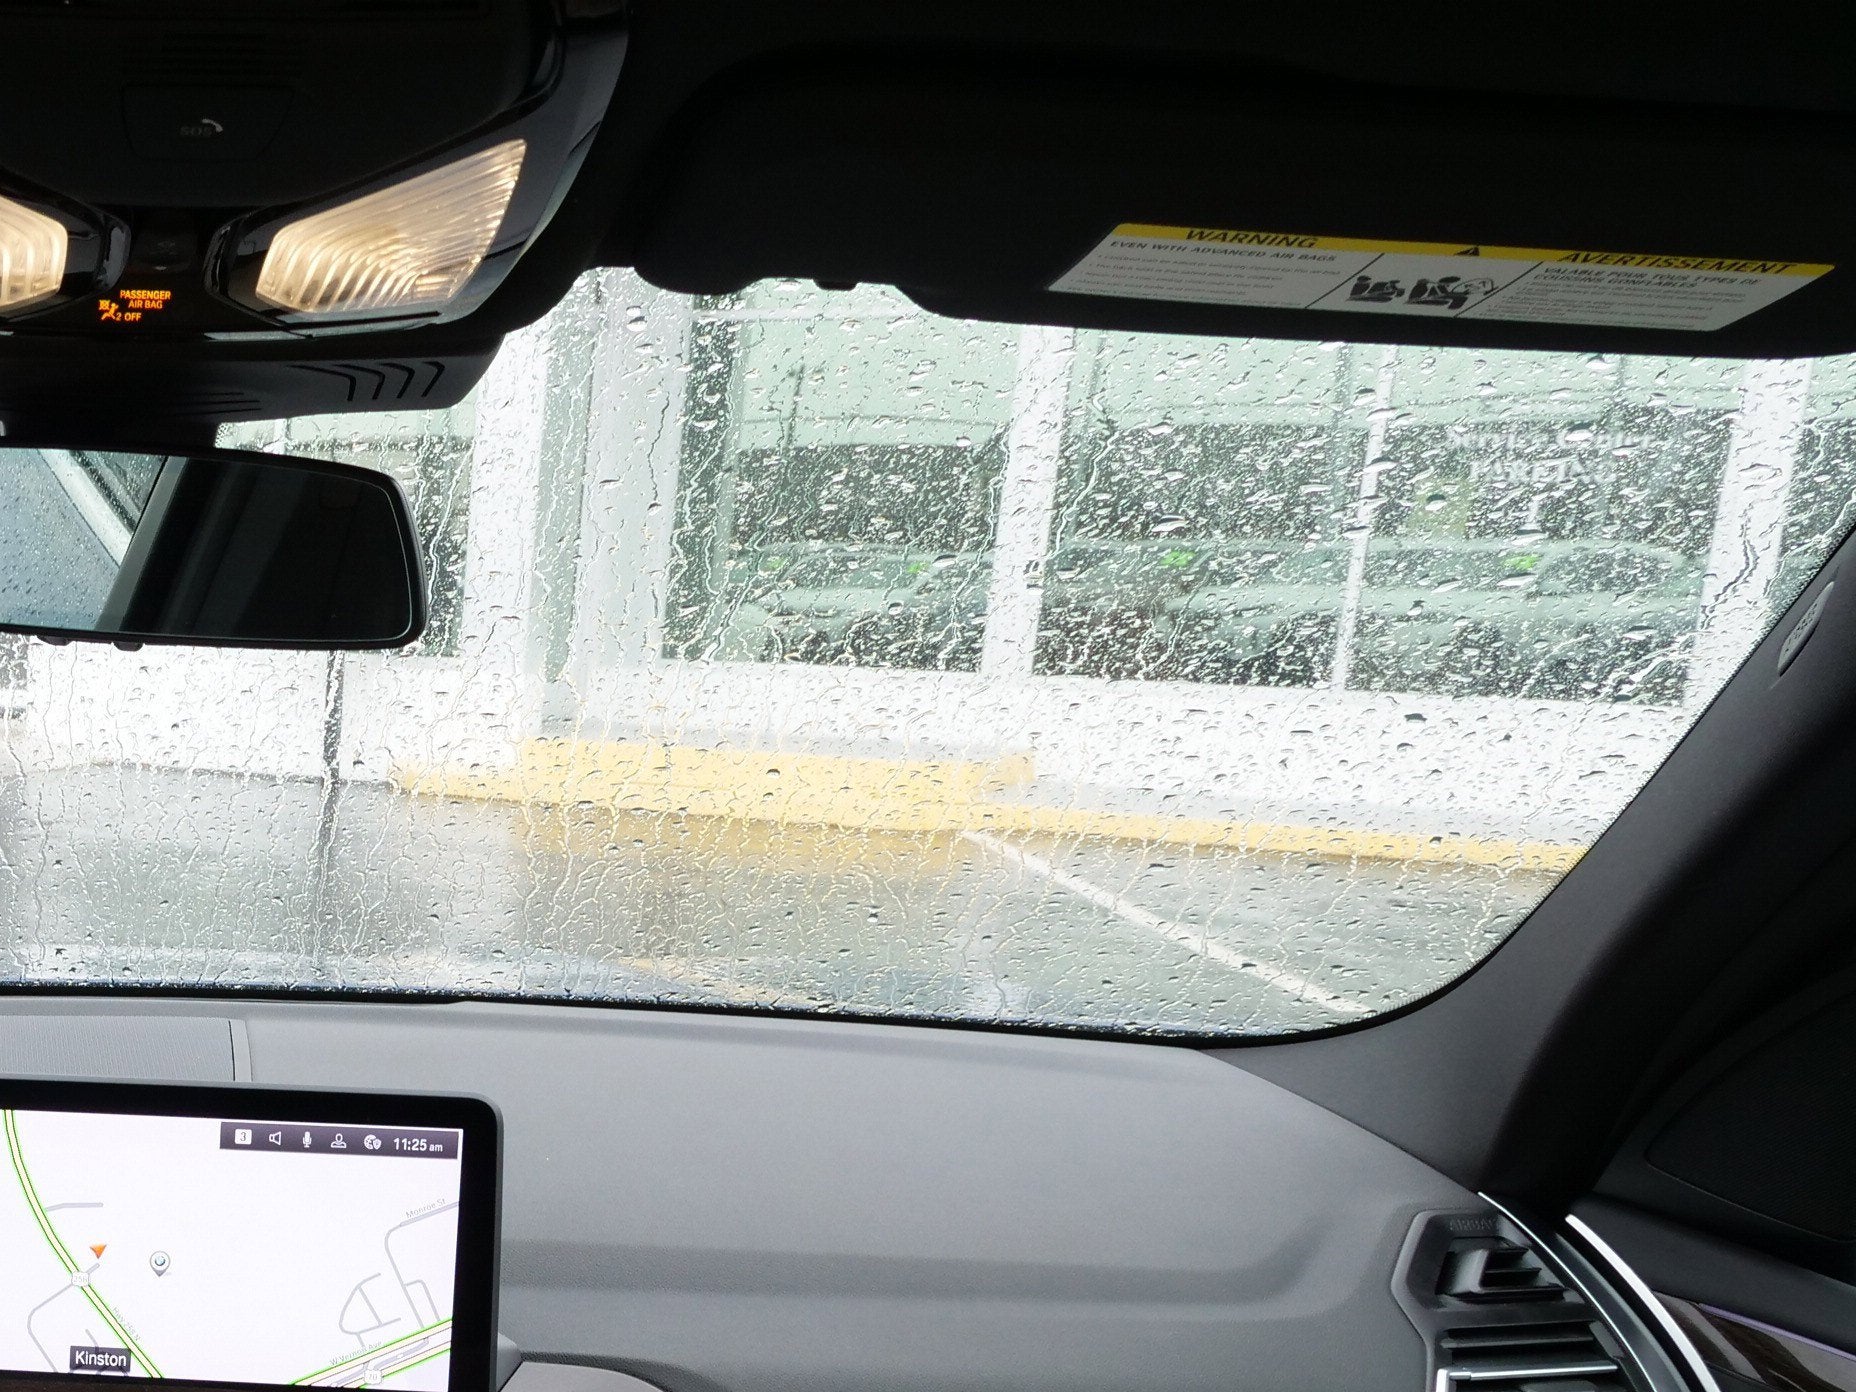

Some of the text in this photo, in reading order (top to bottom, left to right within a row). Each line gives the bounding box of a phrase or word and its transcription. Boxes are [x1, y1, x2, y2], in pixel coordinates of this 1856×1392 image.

[180, 126, 213, 136] SOS
[1186, 229, 1319, 249] WARNING
[1110, 240, 1148, 251] EVEN
[1152, 243, 1188, 252] WITH
[1191, 245, 1266, 257] ADVANCED
[1557, 252, 1794, 274] AVERTISSEMENT
[119, 290, 172, 300] PASSENGER
[128, 300, 163, 309] AIR BAG
[124, 312, 142, 321] OFF
[393, 1138, 428, 1152] 11:25
[429, 1143, 443, 1152] am
[405, 1203, 436, 1219] Monroe
[74, 1350, 127, 1367] Kinston
